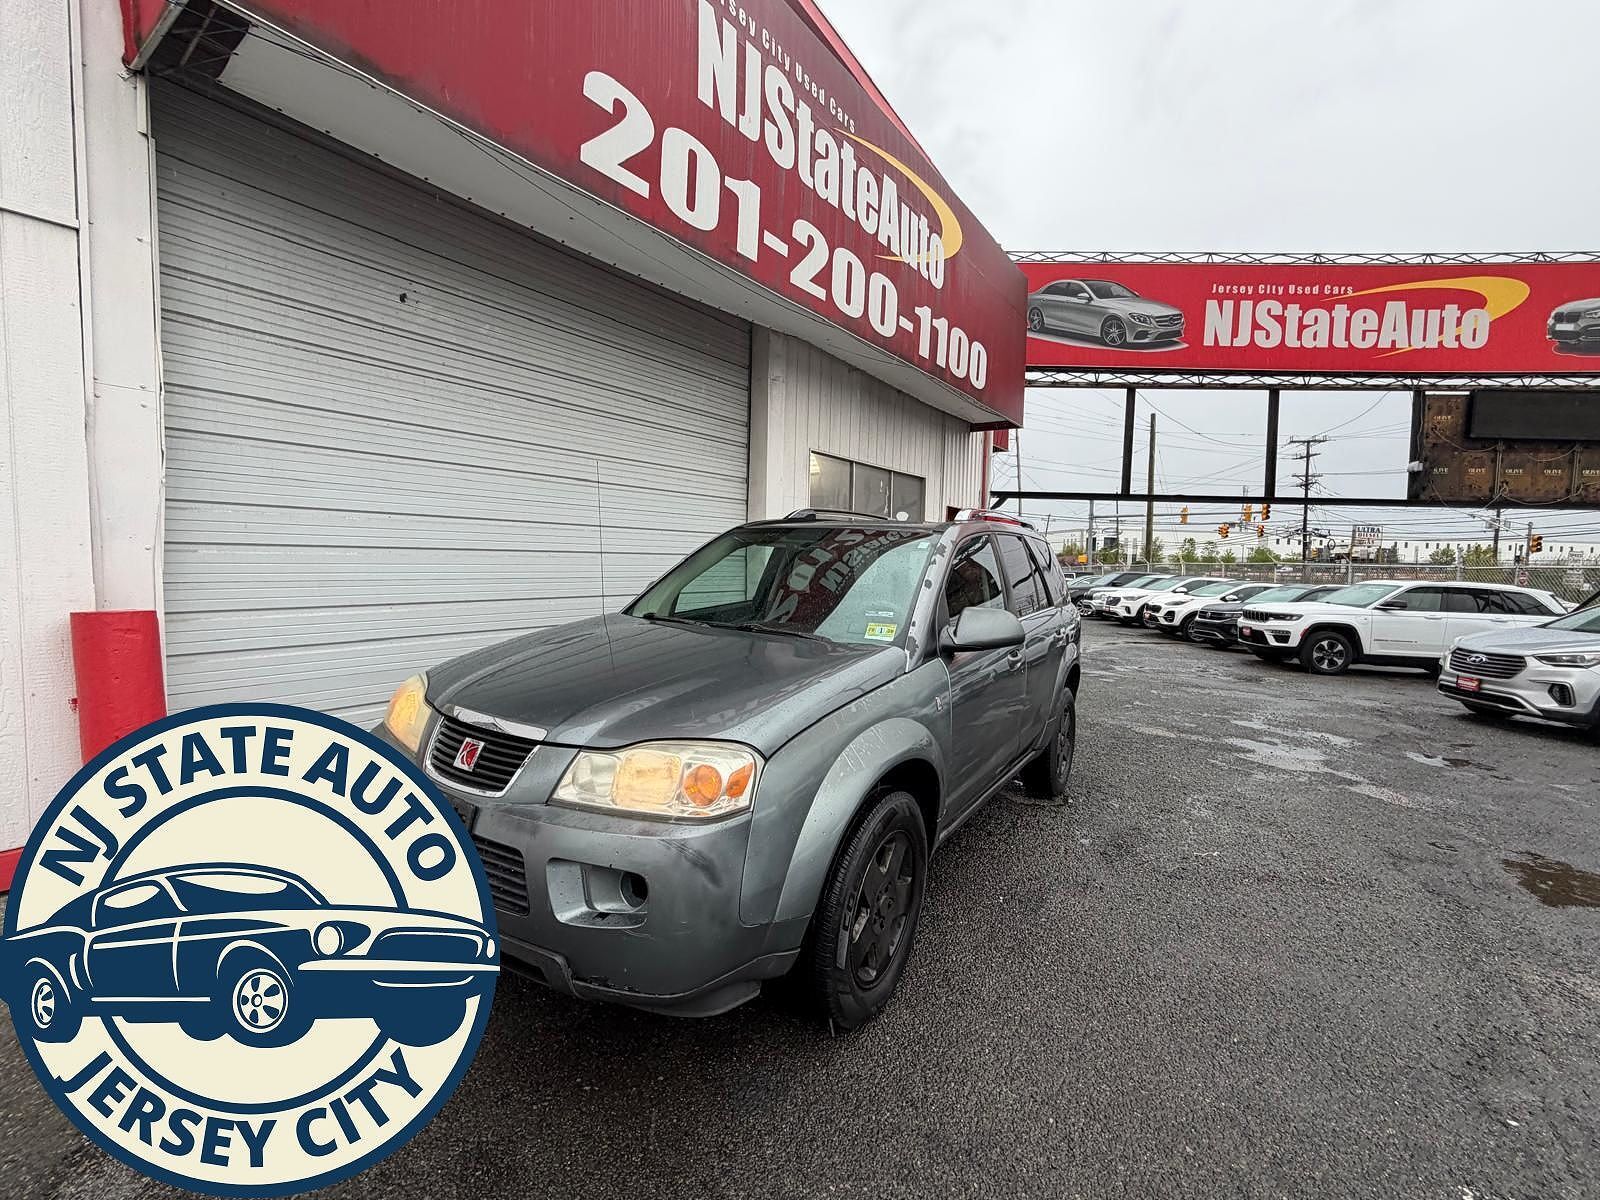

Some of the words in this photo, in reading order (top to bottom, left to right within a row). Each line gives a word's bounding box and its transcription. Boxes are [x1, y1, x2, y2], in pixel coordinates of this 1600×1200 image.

[762, 28, 790, 71] City
[796, 62, 825, 105] Used
[830, 97, 855, 133] Cars
[698, 0, 945, 289] NJStateAuto
[580, 71, 987, 390] 201-200-1100
[1203, 299, 1490, 349] NJStateAuto
[1212, 284, 1253, 295] Jersey
[1258, 284, 1284, 295] City
[1288, 284, 1319, 295] Used
[1324, 284, 1353, 295] Cars
